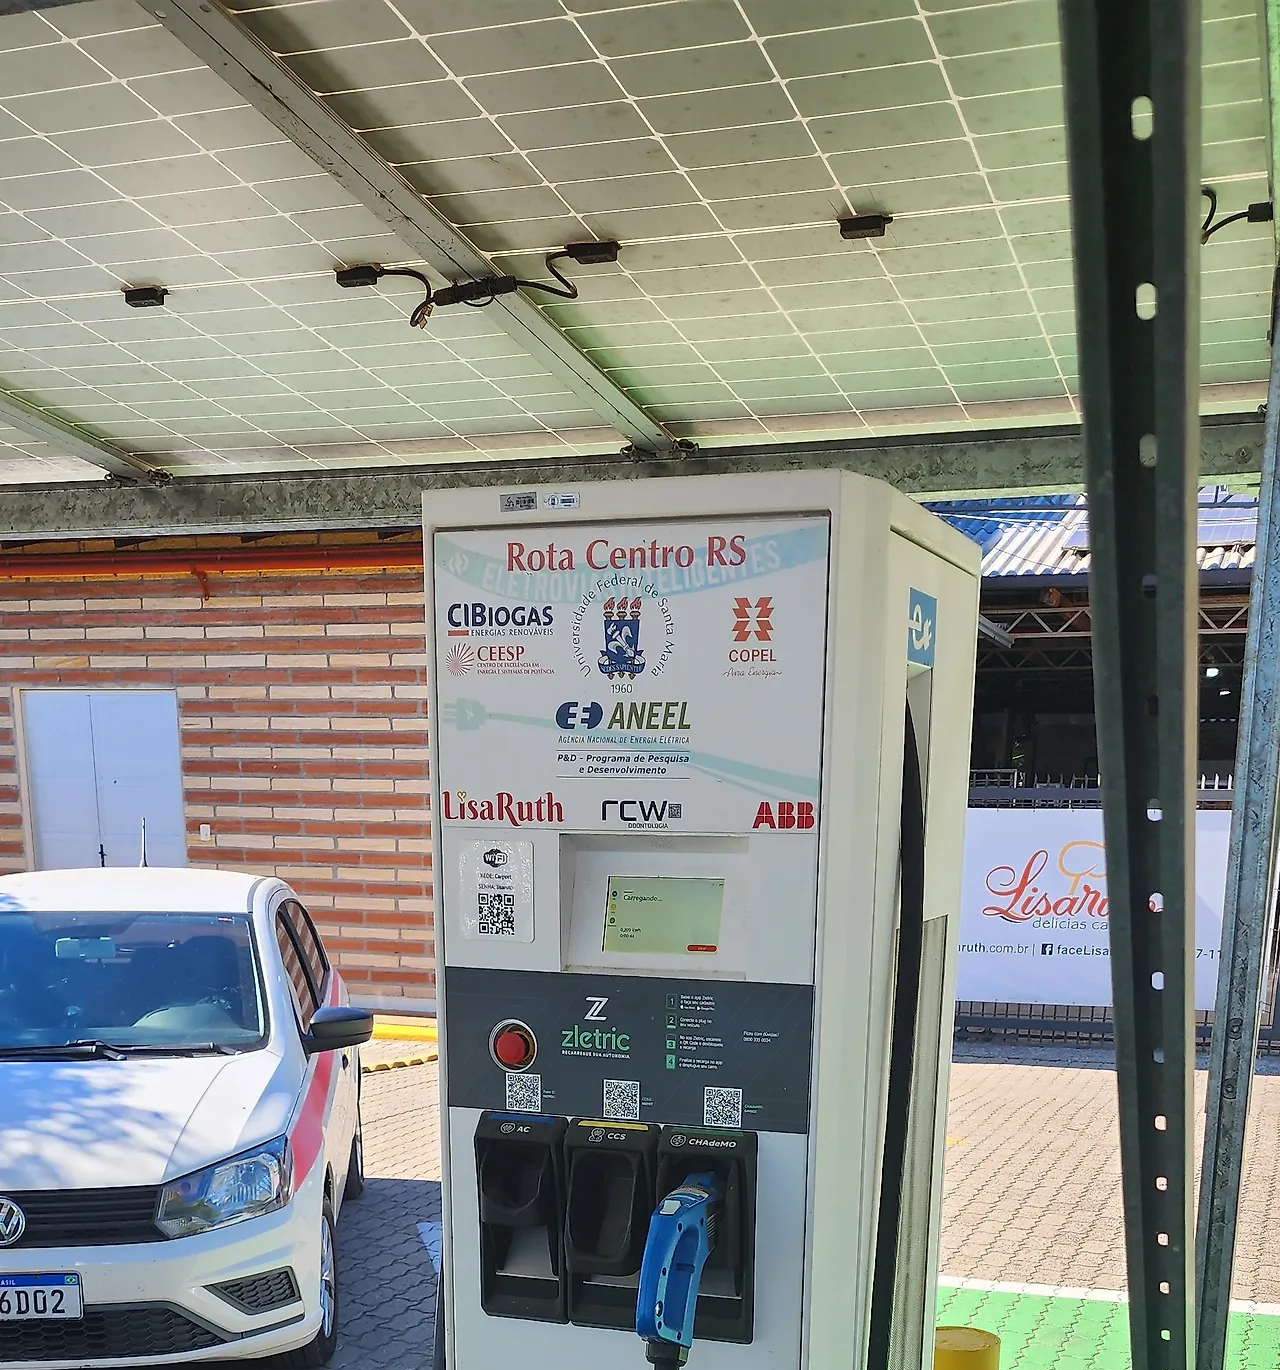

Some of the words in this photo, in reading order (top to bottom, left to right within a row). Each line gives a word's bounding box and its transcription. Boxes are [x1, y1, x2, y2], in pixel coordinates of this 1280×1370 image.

[507, 542, 575, 573] Rota
[586, 539, 694, 571] Centro
[707, 535, 746, 567] RS
[596, 573, 644, 593] Federal
[644, 582, 659, 599] de
[657, 597, 674, 635] Santa
[471, 628, 506, 637] ENERGIAS
[509, 627, 554, 636] RENOVÁVEIS
[570, 590, 596, 678] Universidade
[477, 645, 525, 662] CEESP
[651, 640, 675, 678] Maria
[728, 649, 777, 662] COPEL
[747, 666, 777, 679] Energia
[611, 684, 633, 694] 1960
[607, 701, 691, 730] ANEEL
[587, 735, 617, 744] NACIONAL
[619, 736, 628, 744] DE
[630, 735, 657, 744] ENERGIA
[557, 754, 577, 762] P&D
[586, 754, 631, 764] Programa
[633, 754, 646, 763] de
[648, 755, 690, 764] Pesquisa
[579, 766, 584, 774] e
[587, 766, 667, 775] Desenvolvimento
[441, 790, 565, 827] LisaRuth
[752, 801, 815, 830] ABB
[982, 849, 1110, 923] Lisaru
[957, 942, 1029, 954] ruth.com.br
[1057, 944, 1110, 956] faceLisa
[1195, 948, 1221, 959] 7-11
[561, 1024, 631, 1051] zletric
[516, 1125, 531, 1133] AC
[607, 1132, 626, 1141] CCS
[688, 1138, 736, 1149] CHAdeMO
[0, 1289, 66, 1315] 6D02
